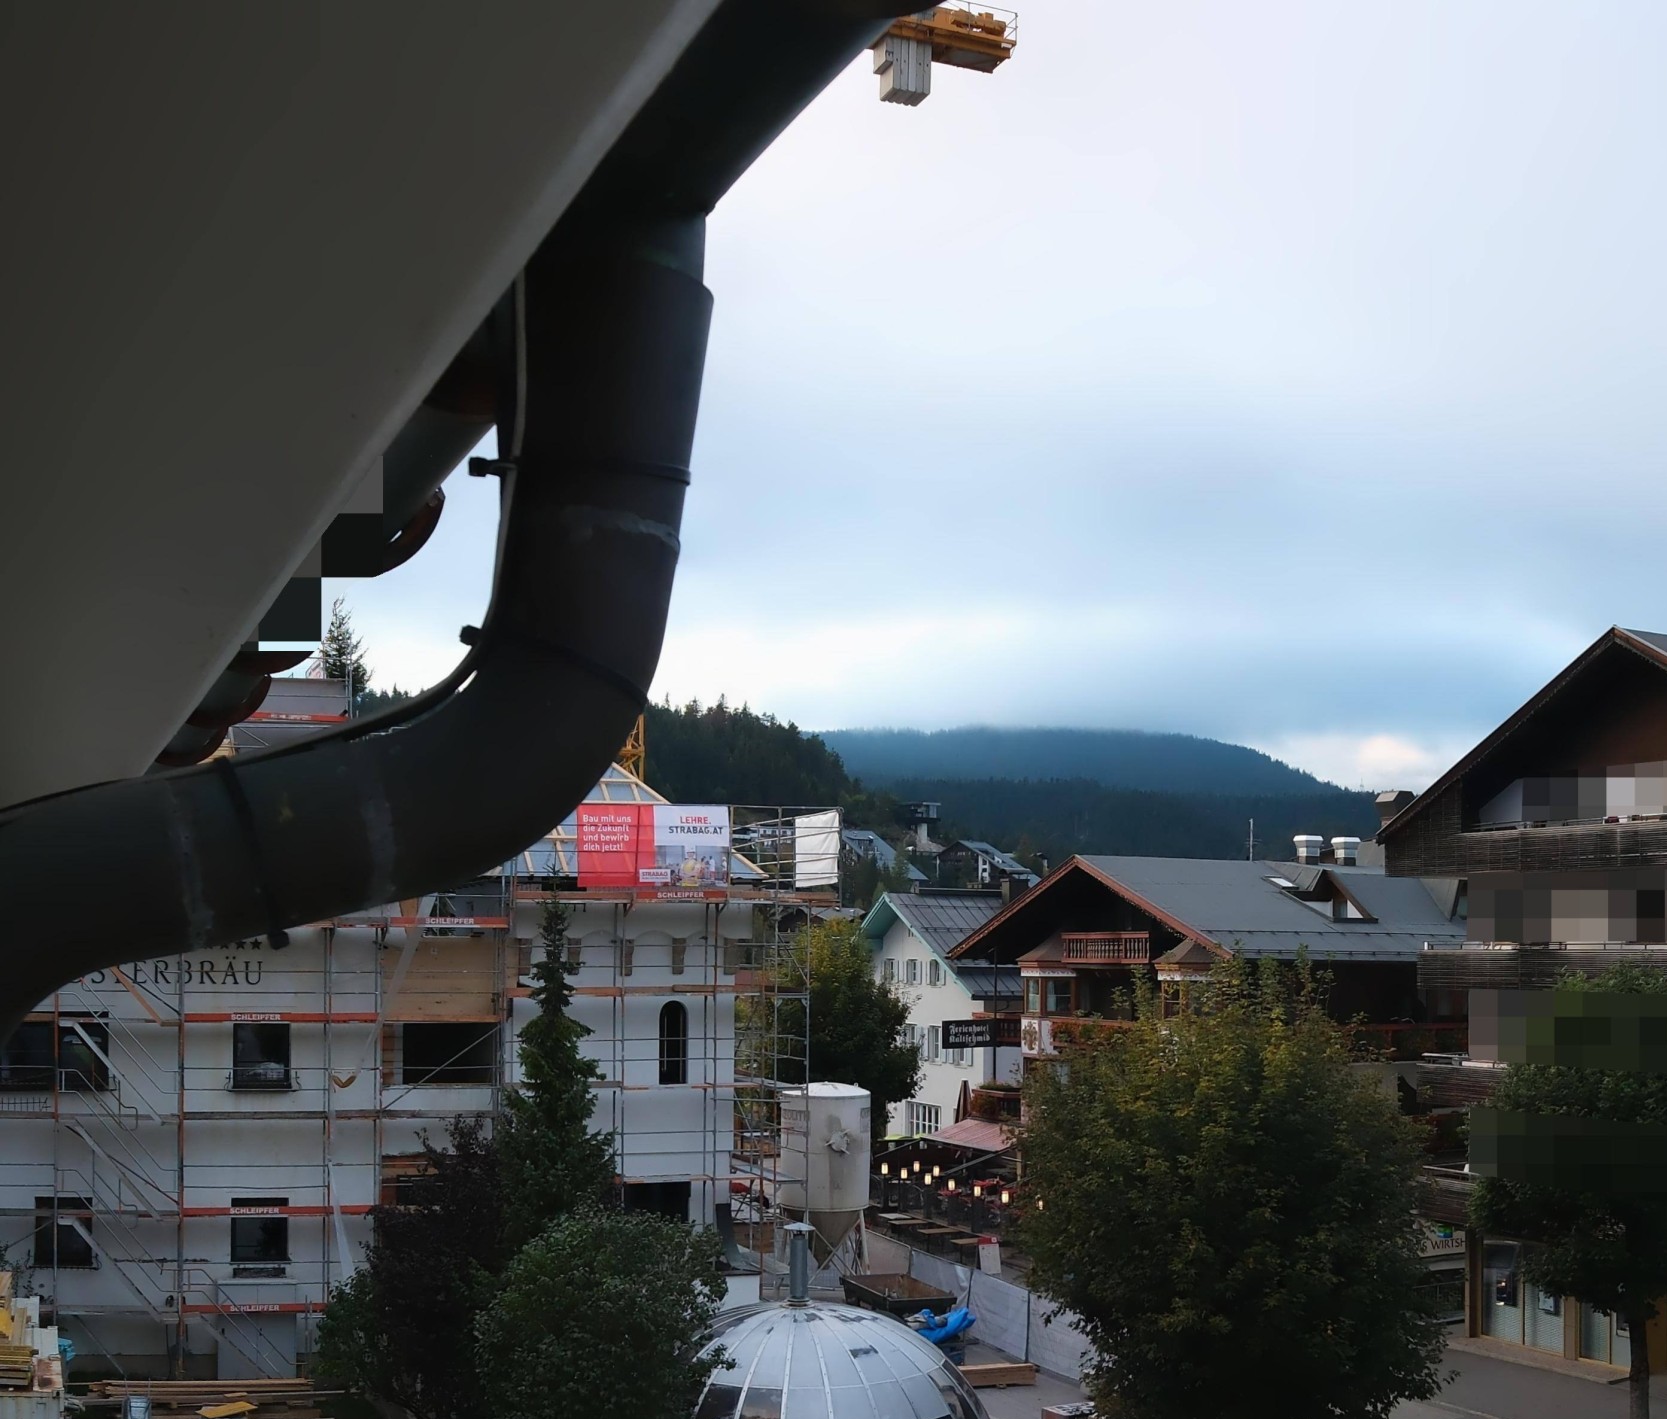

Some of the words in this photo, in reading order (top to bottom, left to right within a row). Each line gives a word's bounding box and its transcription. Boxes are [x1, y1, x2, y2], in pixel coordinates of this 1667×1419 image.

[583, 814, 599, 823] Bau
[601, 815, 614, 823] mit
[680, 816, 712, 825] LEHRE.
[583, 824, 595, 832] die
[597, 824, 629, 832] Zukunft
[668, 826, 723, 835] STRABAG.AT
[583, 834, 598, 842] und
[600, 834, 629, 842] bewirb
[583, 843, 600, 851] dich
[602, 843, 624, 852] jetzt!
[425, 917, 475, 925] SCHLEIPFER
[231, 1013, 281, 1021] SCHLEIPFER
[229, 1206, 280, 1215] SCHLEIPFER
[229, 1304, 280, 1312] SCHLEIPFER
